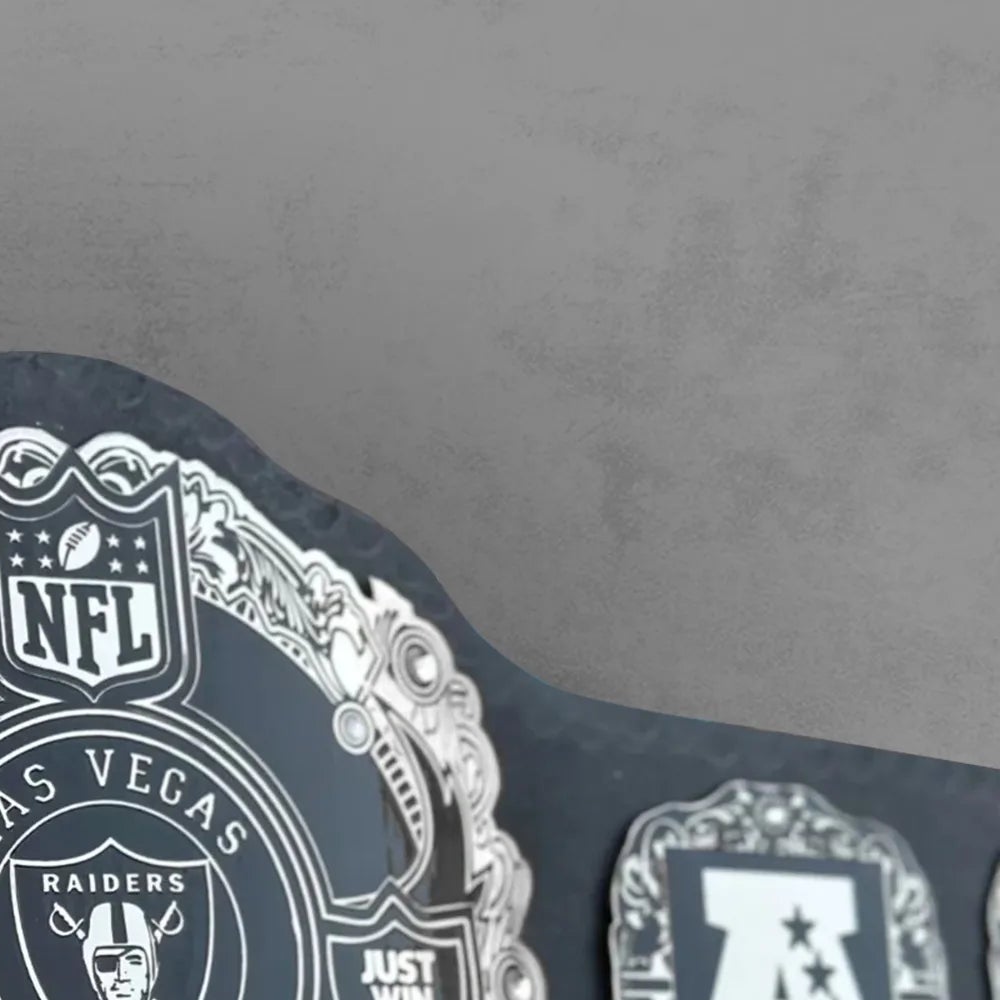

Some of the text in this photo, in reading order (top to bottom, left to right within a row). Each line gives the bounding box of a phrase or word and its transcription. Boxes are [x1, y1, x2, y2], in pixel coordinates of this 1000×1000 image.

[17, 580, 154, 677] NFL
[86, 749, 248, 855] VEGAS
[42, 873, 185, 893] RAIDERS
[361, 949, 436, 984] JUST
